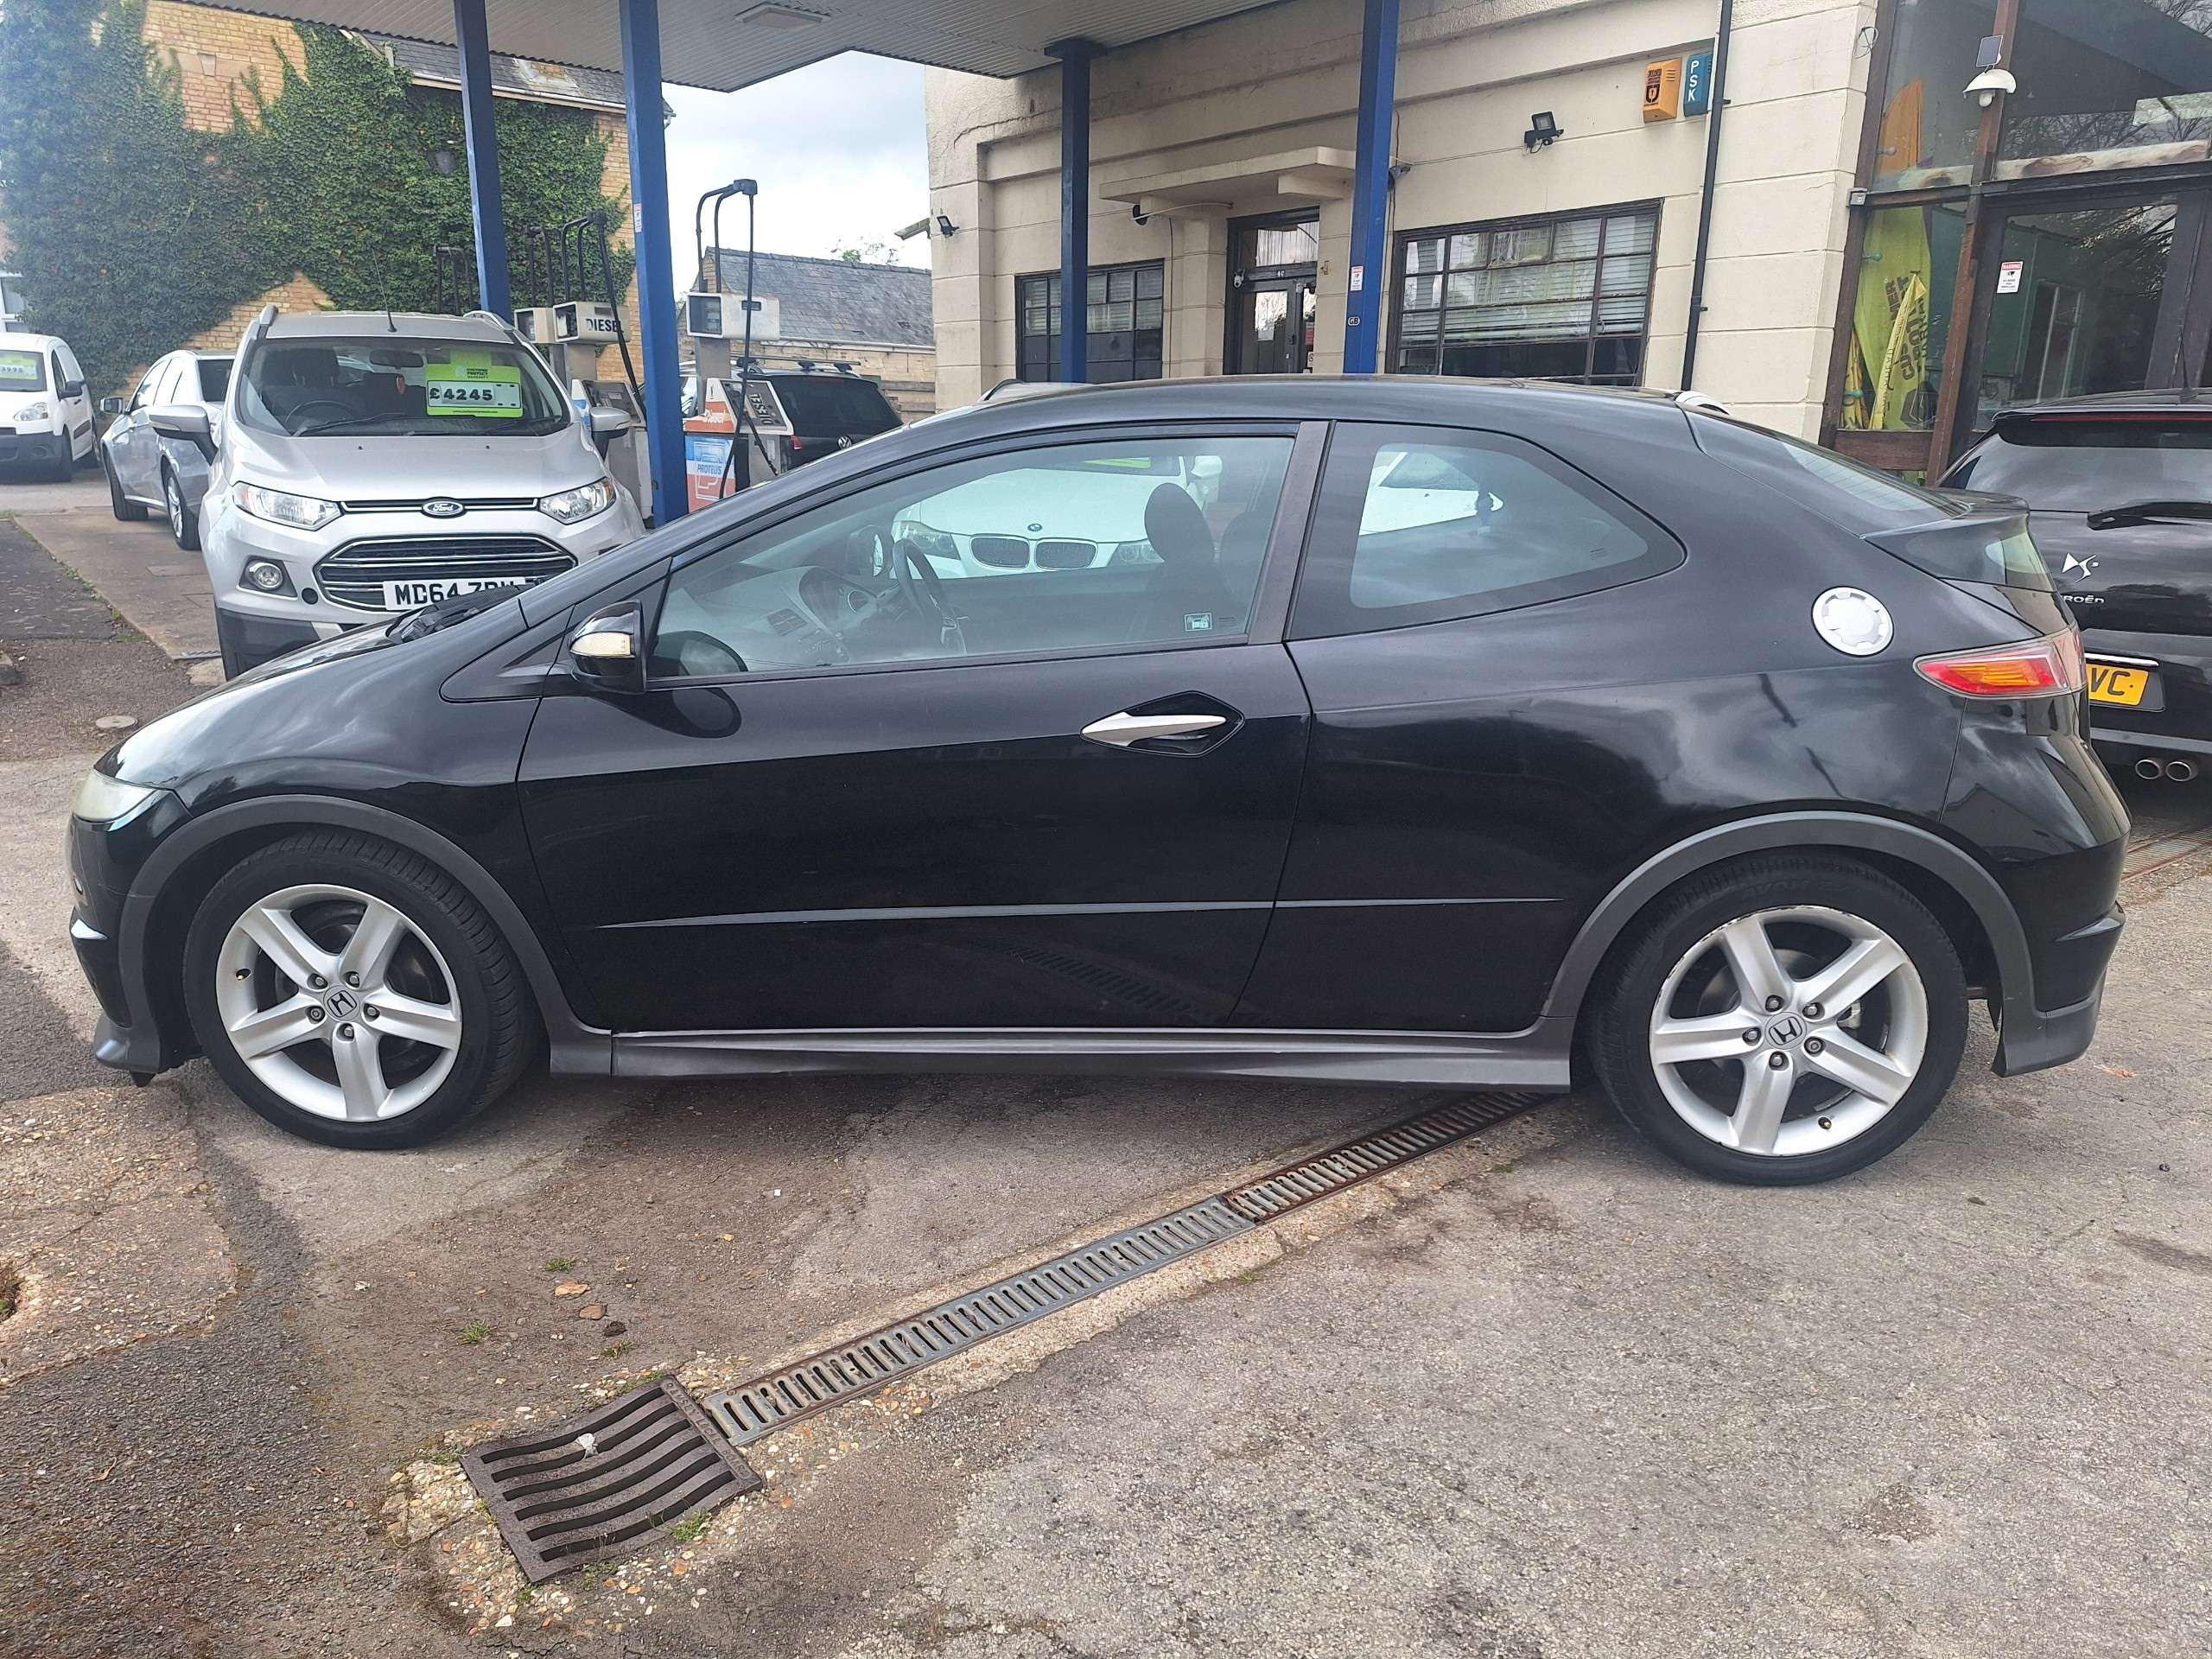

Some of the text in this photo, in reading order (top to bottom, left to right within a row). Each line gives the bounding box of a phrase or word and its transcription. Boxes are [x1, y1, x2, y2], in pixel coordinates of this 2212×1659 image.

[429, 388, 493, 401] £4245
[696, 463, 722, 474] PROTEUS
[432, 503, 454, 512] Ford
